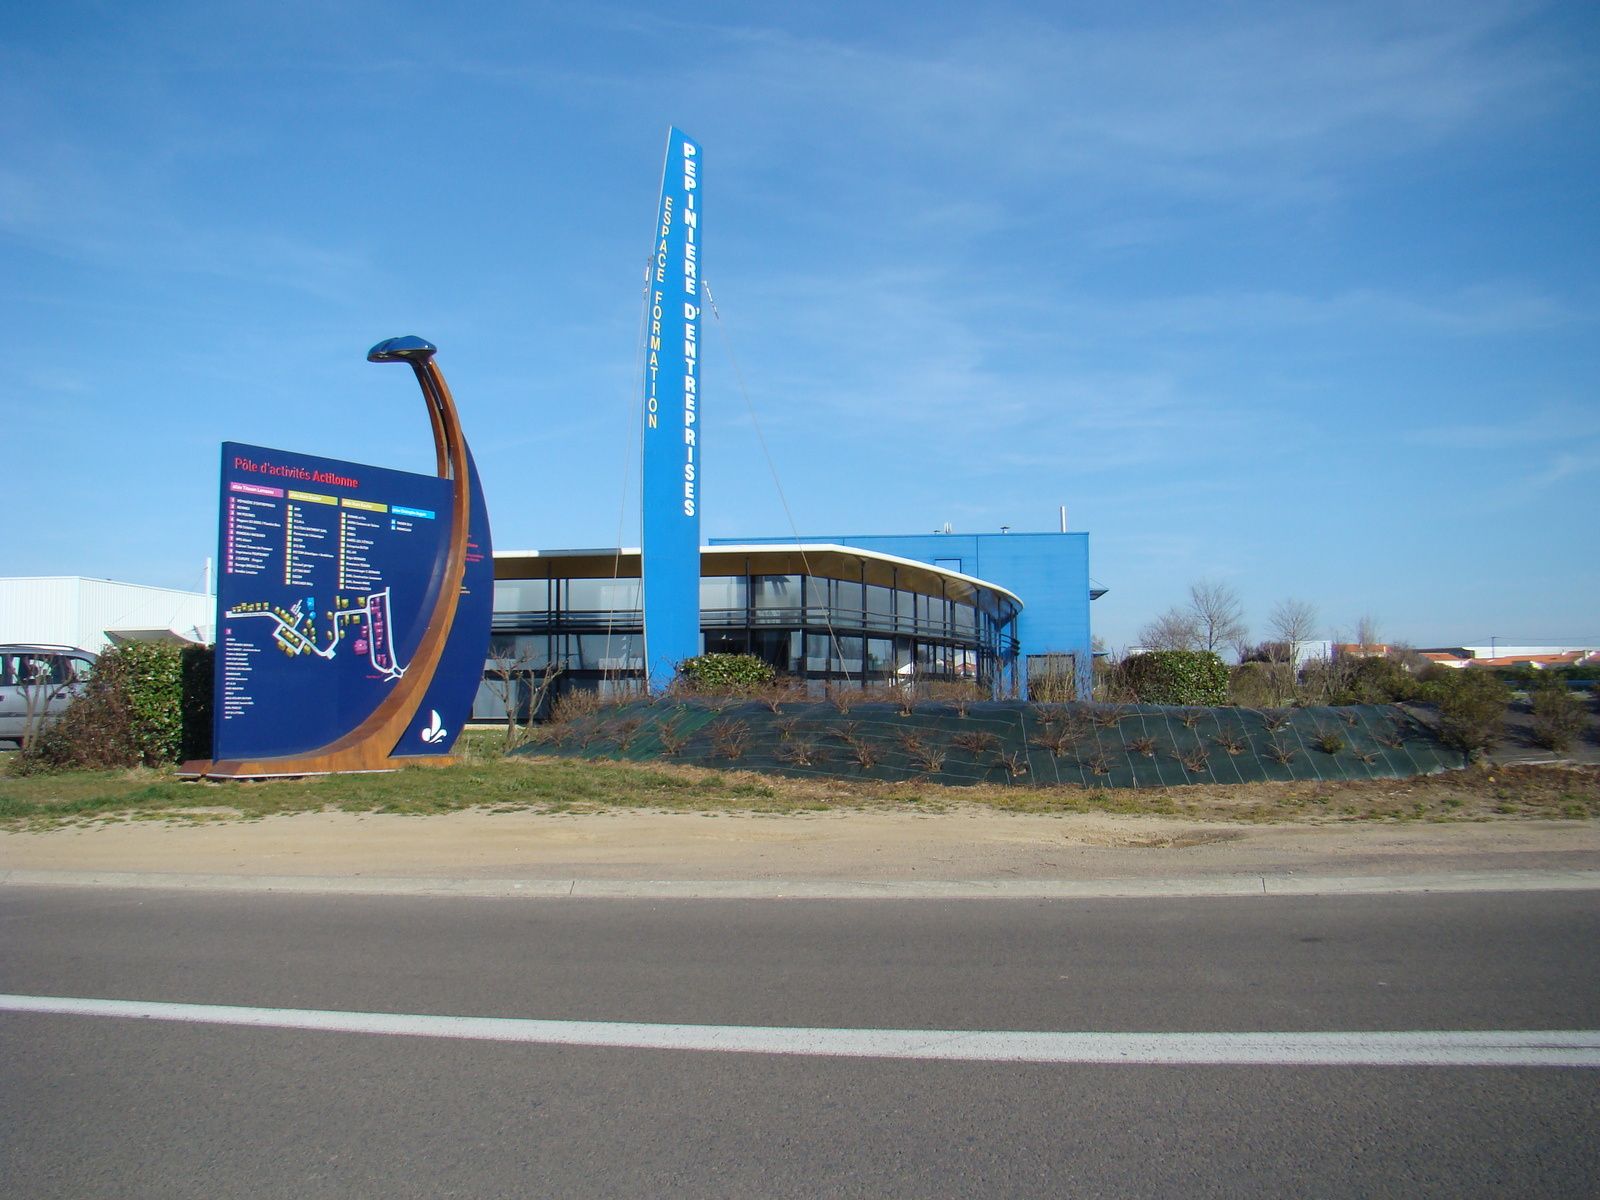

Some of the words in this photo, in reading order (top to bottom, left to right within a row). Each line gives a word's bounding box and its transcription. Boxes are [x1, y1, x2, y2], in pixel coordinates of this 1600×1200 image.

[657, 196, 673, 283] ESPACE
[683, 142, 697, 295] PEPINIERE
[648, 290, 663, 429] FORMATION
[684, 302, 700, 517] D'ENTREPRISES
[234, 457, 258, 473] Pôle
[260, 462, 311, 481] d'activités
[312, 470, 360, 488] Actilonne
